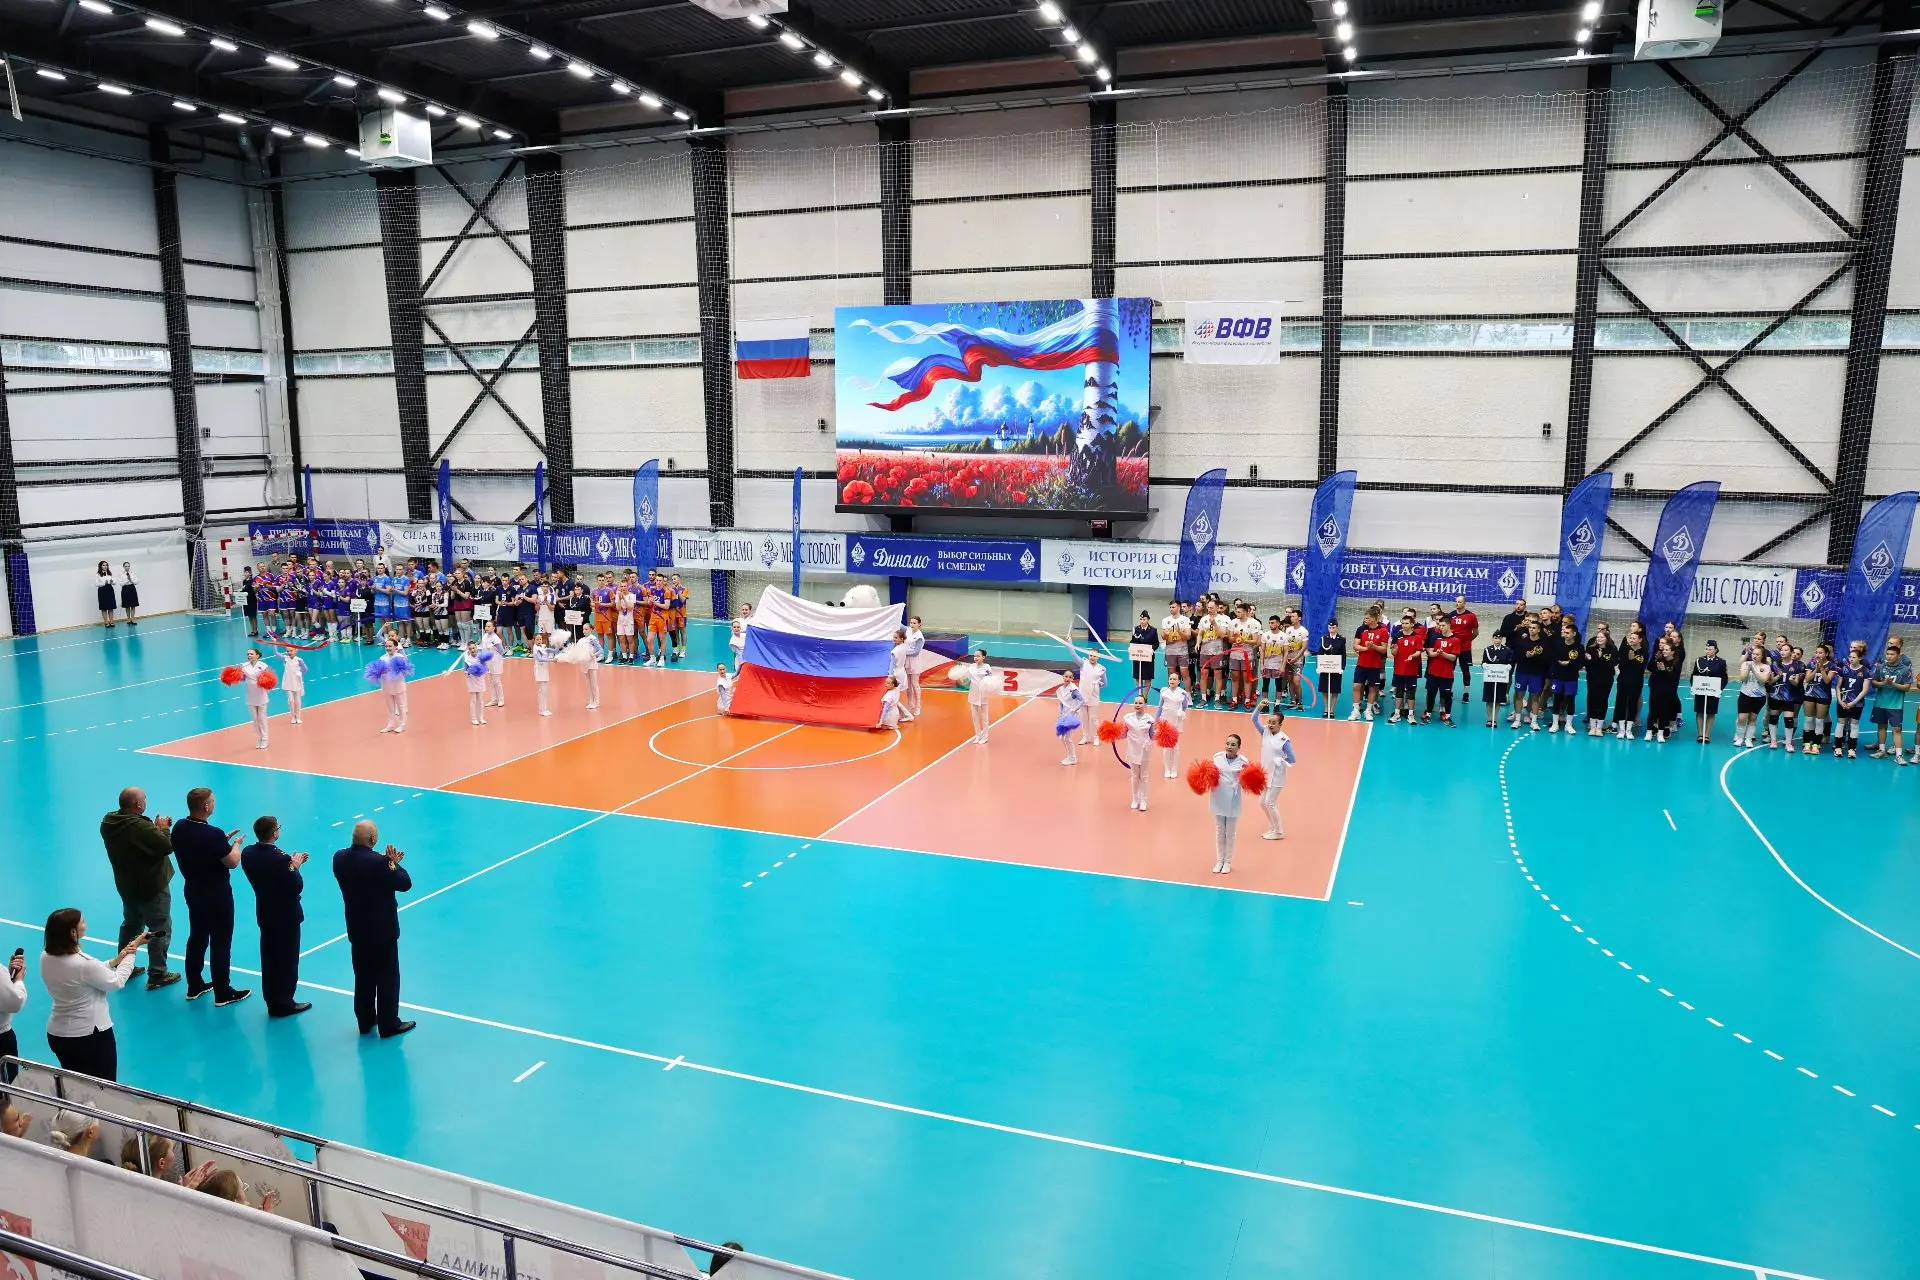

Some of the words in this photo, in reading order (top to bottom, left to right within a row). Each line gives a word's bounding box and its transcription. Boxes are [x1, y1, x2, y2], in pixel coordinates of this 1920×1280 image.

[1215, 317, 1272, 339] ВФВ
[402, 530, 428, 540] СИЛА
[418, 544, 425, 553] И
[427, 544, 480, 555] ЕДСТВЕ!
[521, 534, 552, 556] ВПЕД
[555, 536, 591, 559] ДИНАМО
[613, 536, 630, 558] МЫ
[630, 537, 637, 559] С
[678, 536, 709, 561] ВПЕРЁД
[713, 539, 753, 565] ДИНАМО
[806, 537, 841, 565] ТОБОЙ!
[872, 547, 932, 569] Динамо
[937, 550, 969, 561] ВЫБОР
[968, 551, 1012, 561] СИЛЬНЫХ
[1088, 550, 1157, 564] ИСТОРИЯ
[937, 561, 945, 570] И
[946, 562, 986, 572] СМЕЛЫХ!
[1082, 566, 1151, 580] ИСТОРИЯ
[1380, 564, 1489, 579] УЧАСТНИКАМ
[1339, 578, 1467, 594] СОРЕВНОВАНИЙ!
[1691, 576, 1717, 604] МЫ
[1720, 577, 1730, 605] С
[1733, 571, 1784, 607] ТОБОЙ!
[1003, 670, 1018, 692] 3
[1848, 677, 1857, 688] 7
[440, 1253, 542, 1280] АДМИН
